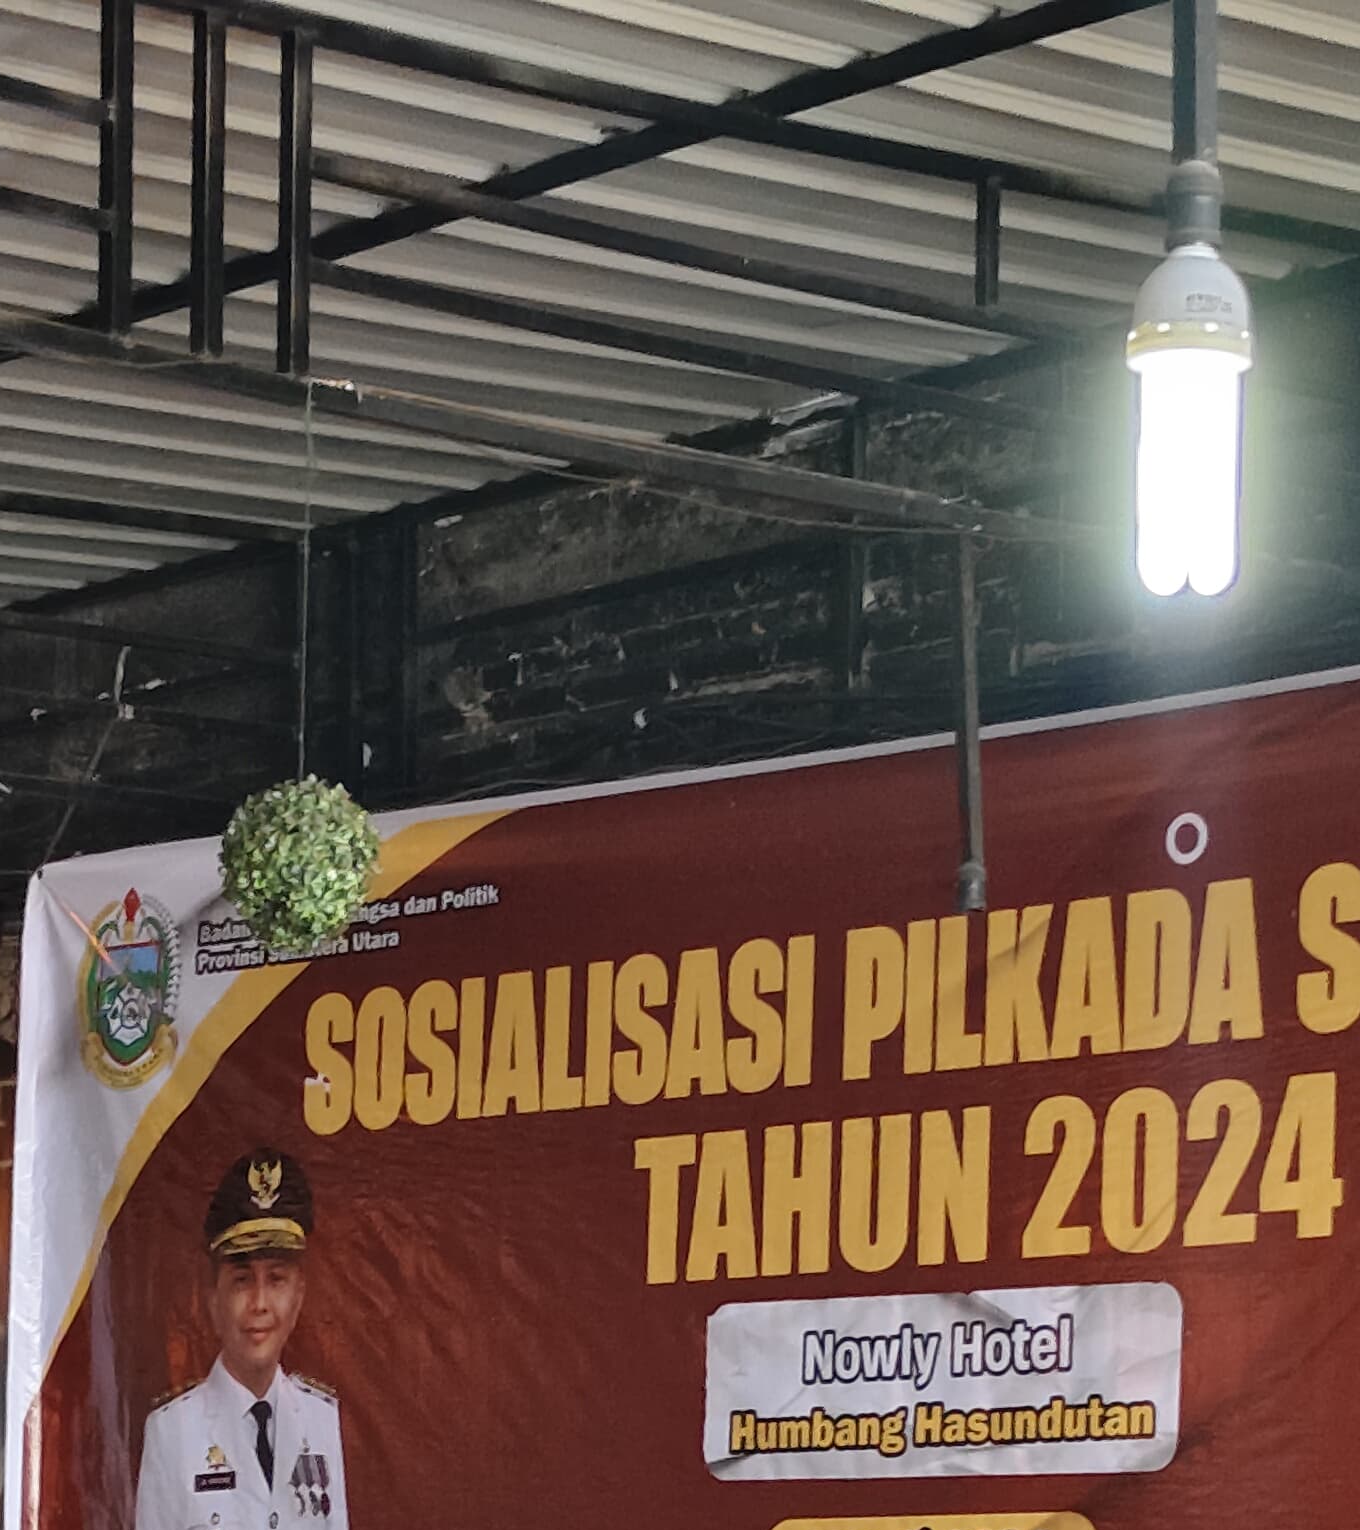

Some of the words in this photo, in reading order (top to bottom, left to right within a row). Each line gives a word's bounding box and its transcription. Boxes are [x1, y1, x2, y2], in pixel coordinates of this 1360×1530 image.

[403, 895, 437, 916] dan
[441, 884, 499, 910] Politik
[197, 946, 265, 974] Provinsi
[352, 931, 400, 952] Utara
[304, 934, 814, 1136] SOSIALISASI
[843, 878, 1263, 1081] PILKADA
[633, 1105, 990, 1285] TAHUN
[1022, 1072, 1343, 1260] 2024
[802, 1323, 940, 1390] Nowly
[950, 1314, 1074, 1377] Hotel
[730, 1407, 908, 1457] Humbang
[913, 1394, 1155, 1447] Hasundutan
